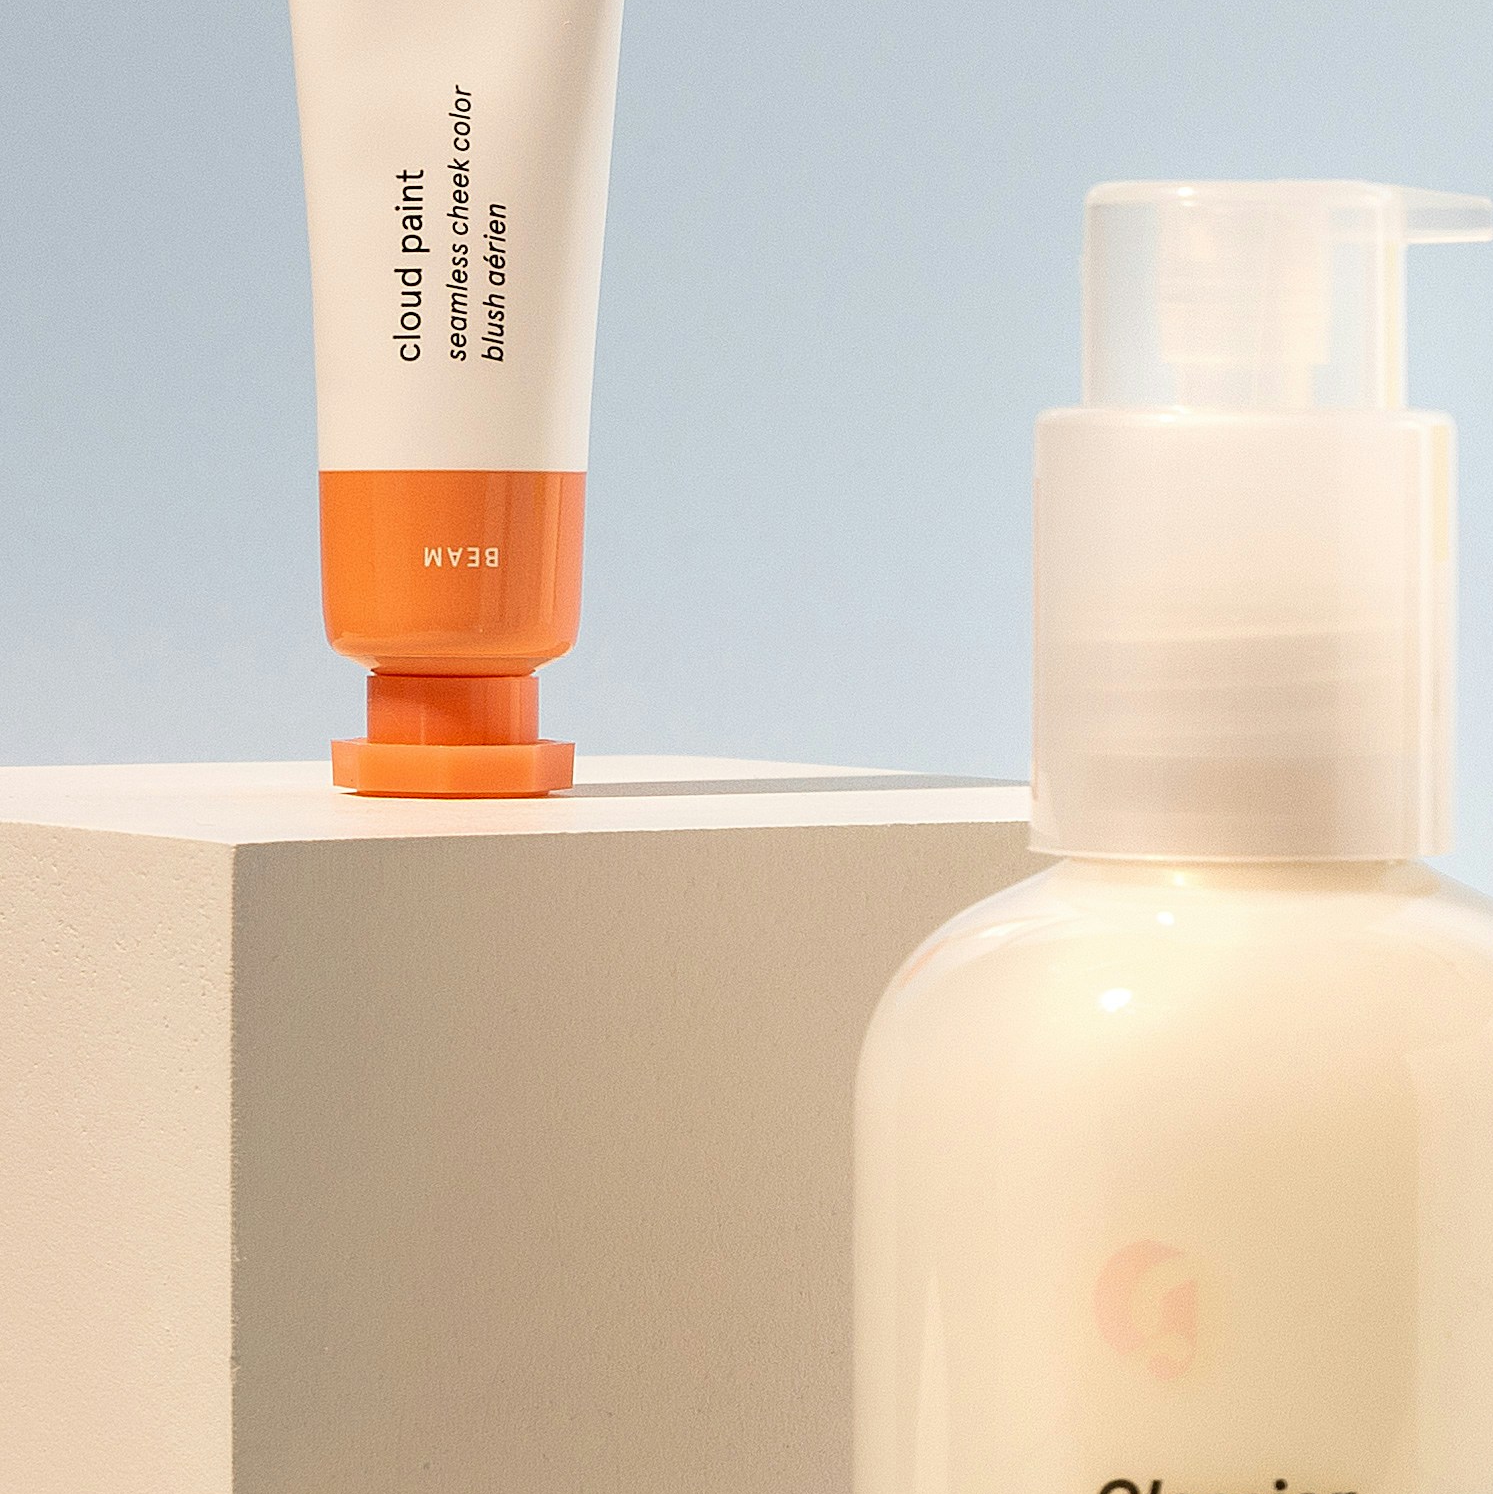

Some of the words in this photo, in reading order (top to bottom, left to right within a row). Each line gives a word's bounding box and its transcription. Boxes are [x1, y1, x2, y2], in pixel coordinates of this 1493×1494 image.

[449, 85, 471, 152] color
[395, 170, 430, 253] paint
[447, 158, 469, 235] cheek
[483, 204, 506, 286] aérien
[393, 268, 422, 362] cloud
[446, 244, 468, 361] seamless
[481, 294, 505, 362] blush
[424, 547, 499, 567] BEAM
